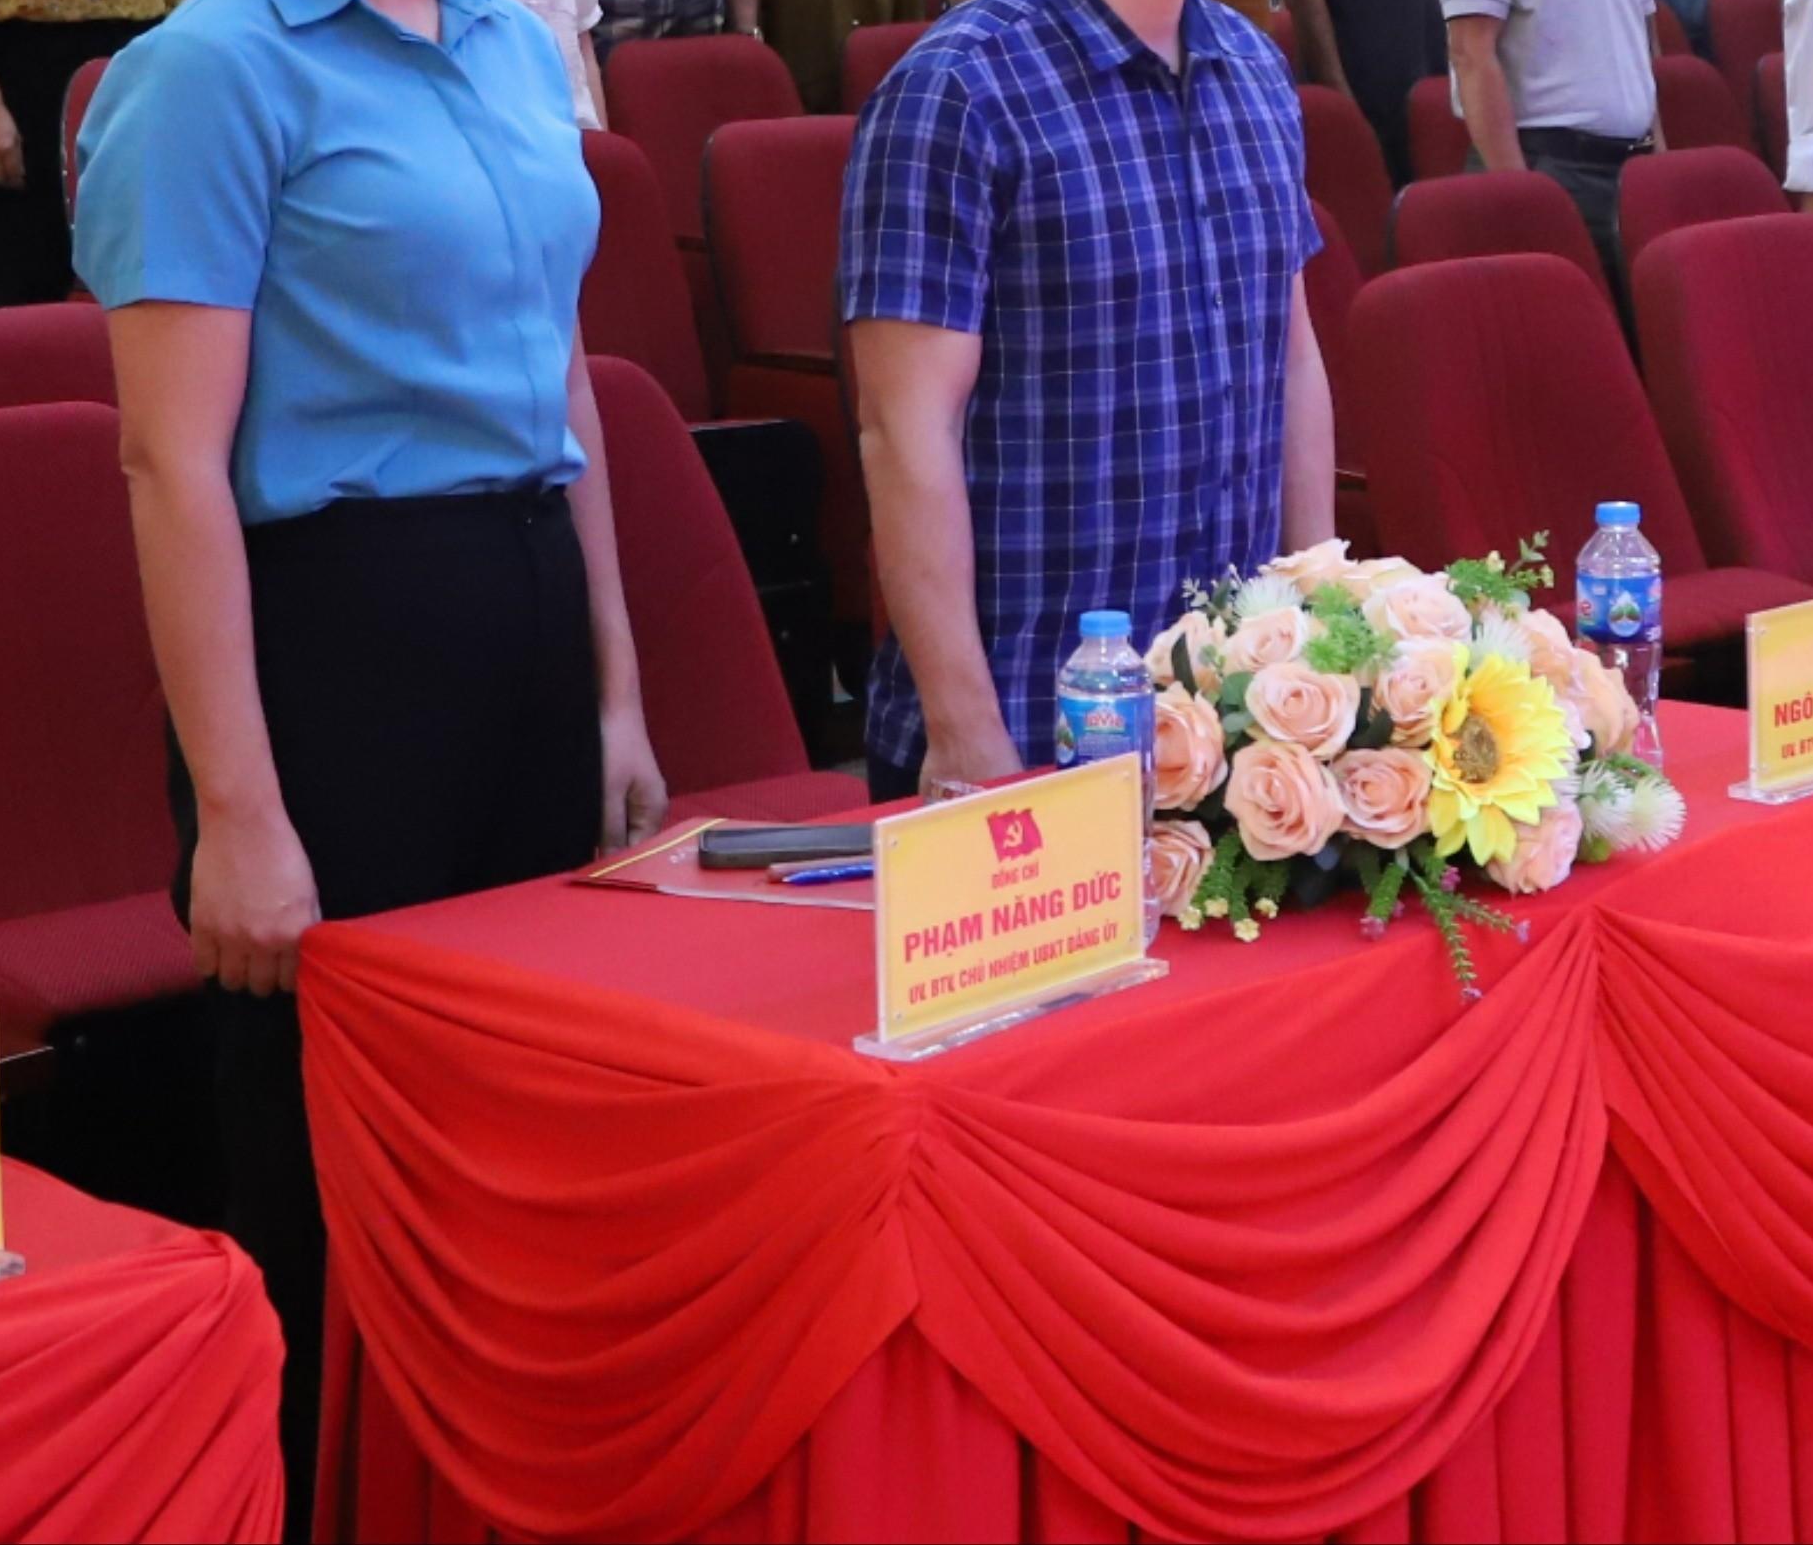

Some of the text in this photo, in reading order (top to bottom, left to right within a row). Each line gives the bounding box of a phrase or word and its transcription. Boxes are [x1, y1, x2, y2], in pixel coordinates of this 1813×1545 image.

[903, 870, 1122, 962] PHẠM NĂNG ĐỨC
